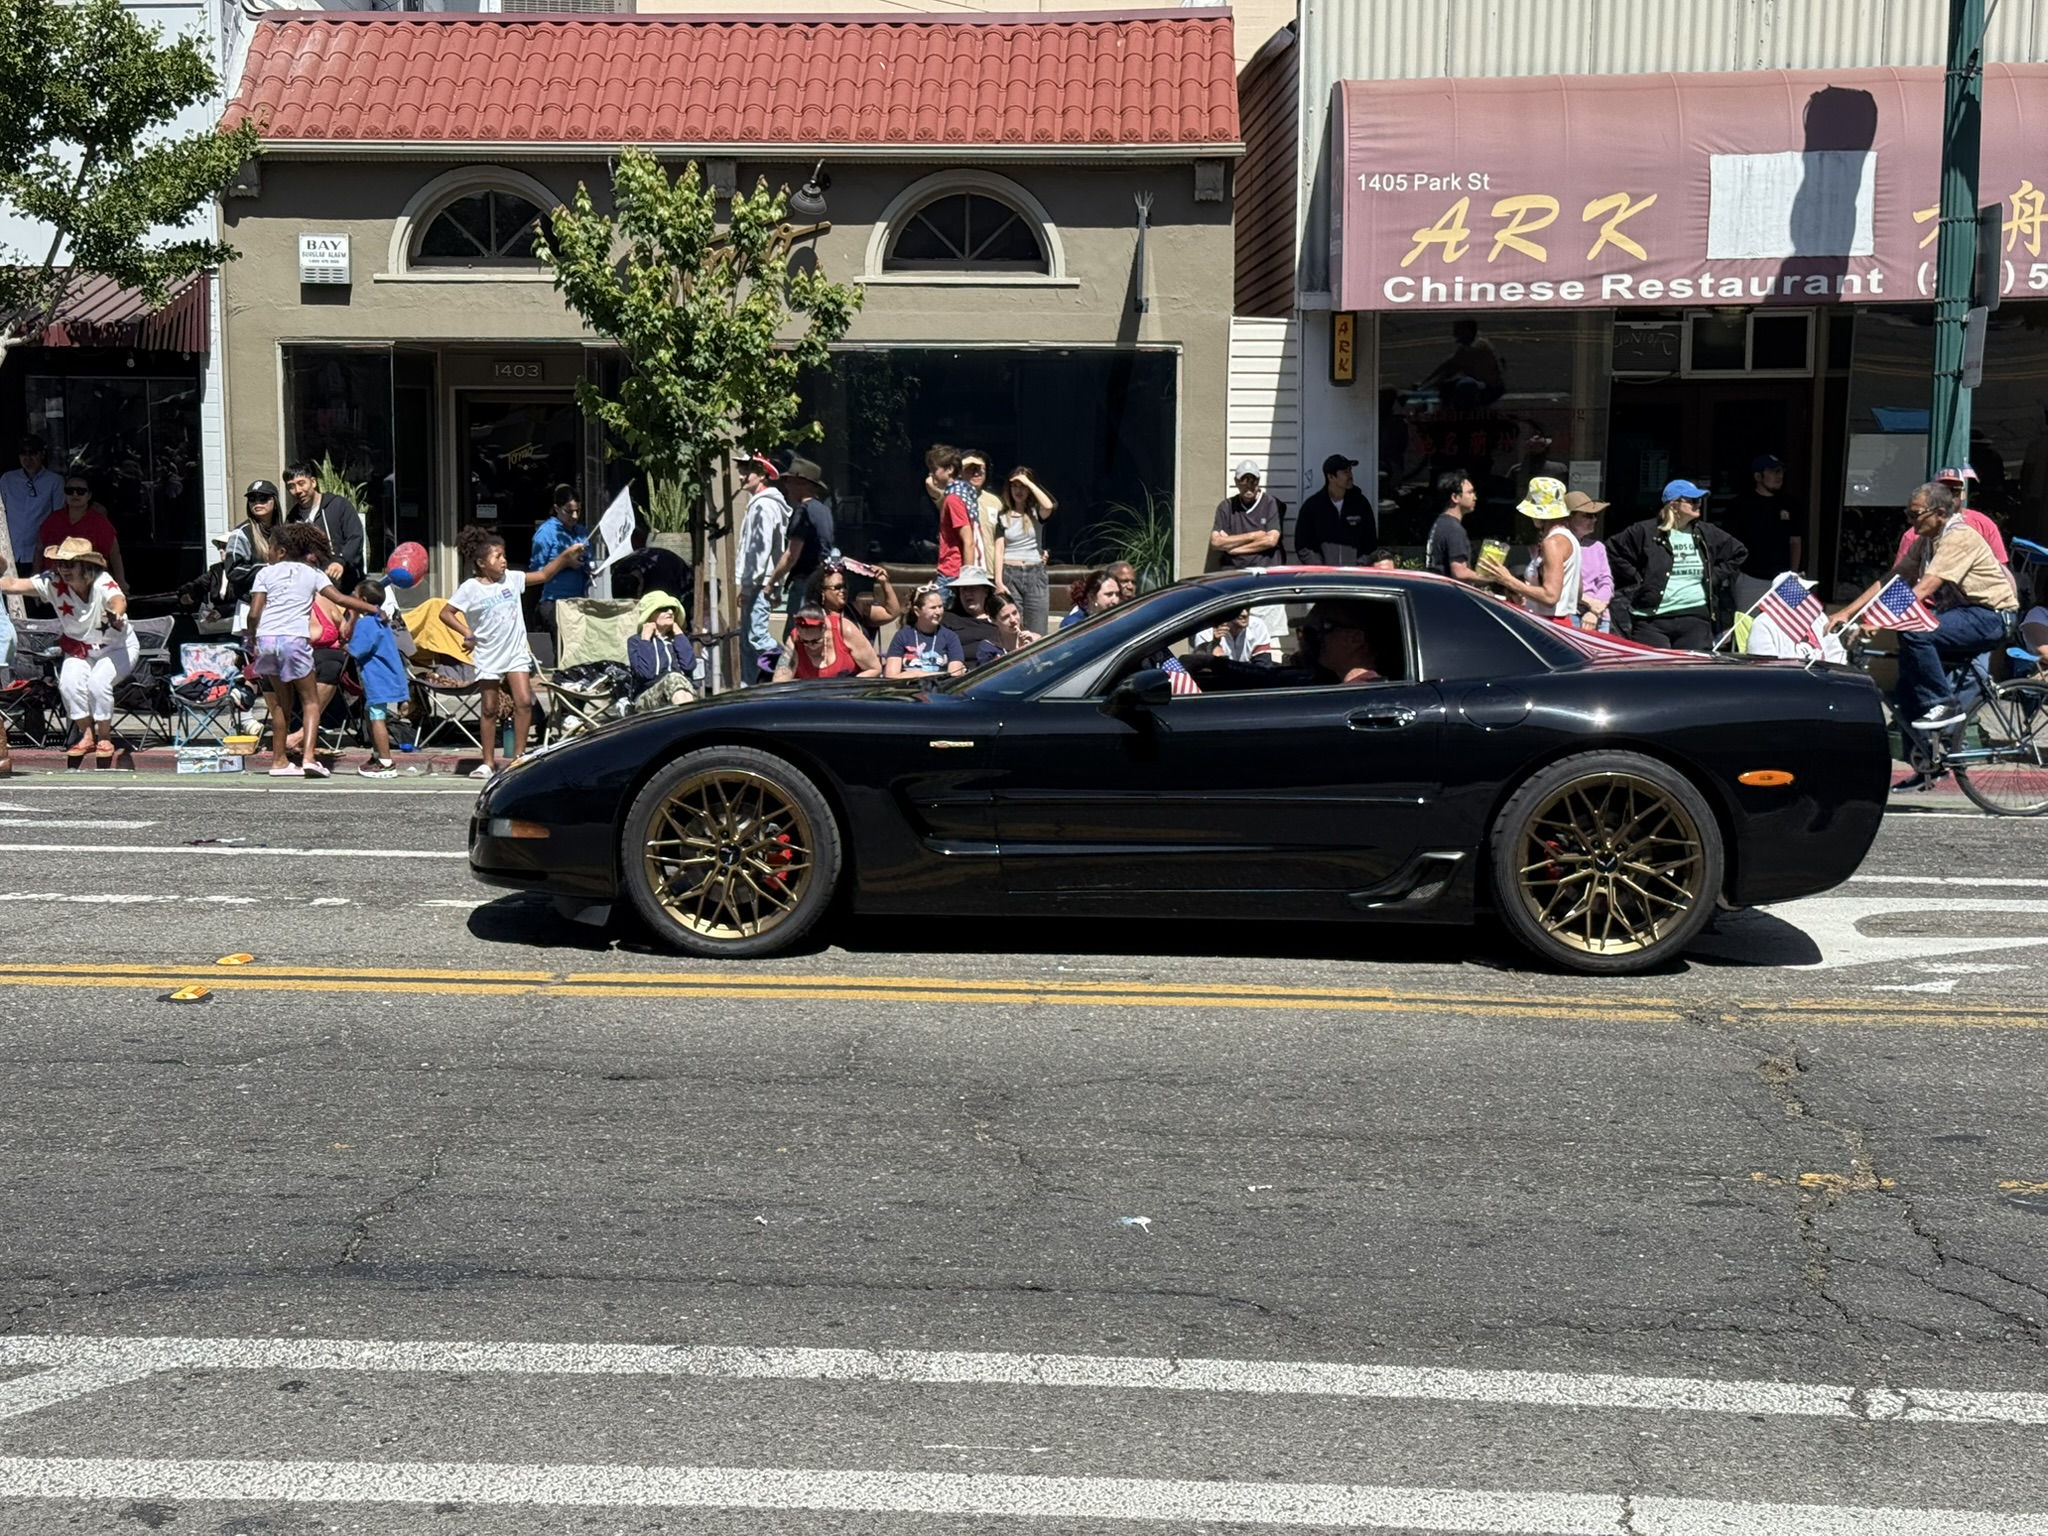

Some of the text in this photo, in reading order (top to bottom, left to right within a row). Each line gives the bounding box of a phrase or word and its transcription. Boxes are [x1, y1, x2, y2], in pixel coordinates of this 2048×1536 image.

[1357, 173, 1408, 191] 1405
[1414, 172, 1462, 191] Park
[1467, 172, 1490, 191] St
[1400, 191, 1658, 268] ARK
[307, 240, 342, 250] BAY
[1383, 276, 1585, 303] Chinese
[1602, 267, 1884, 300] Restaurant
[1338, 321, 1350, 372] ARK
[495, 364, 539, 378] 1403
